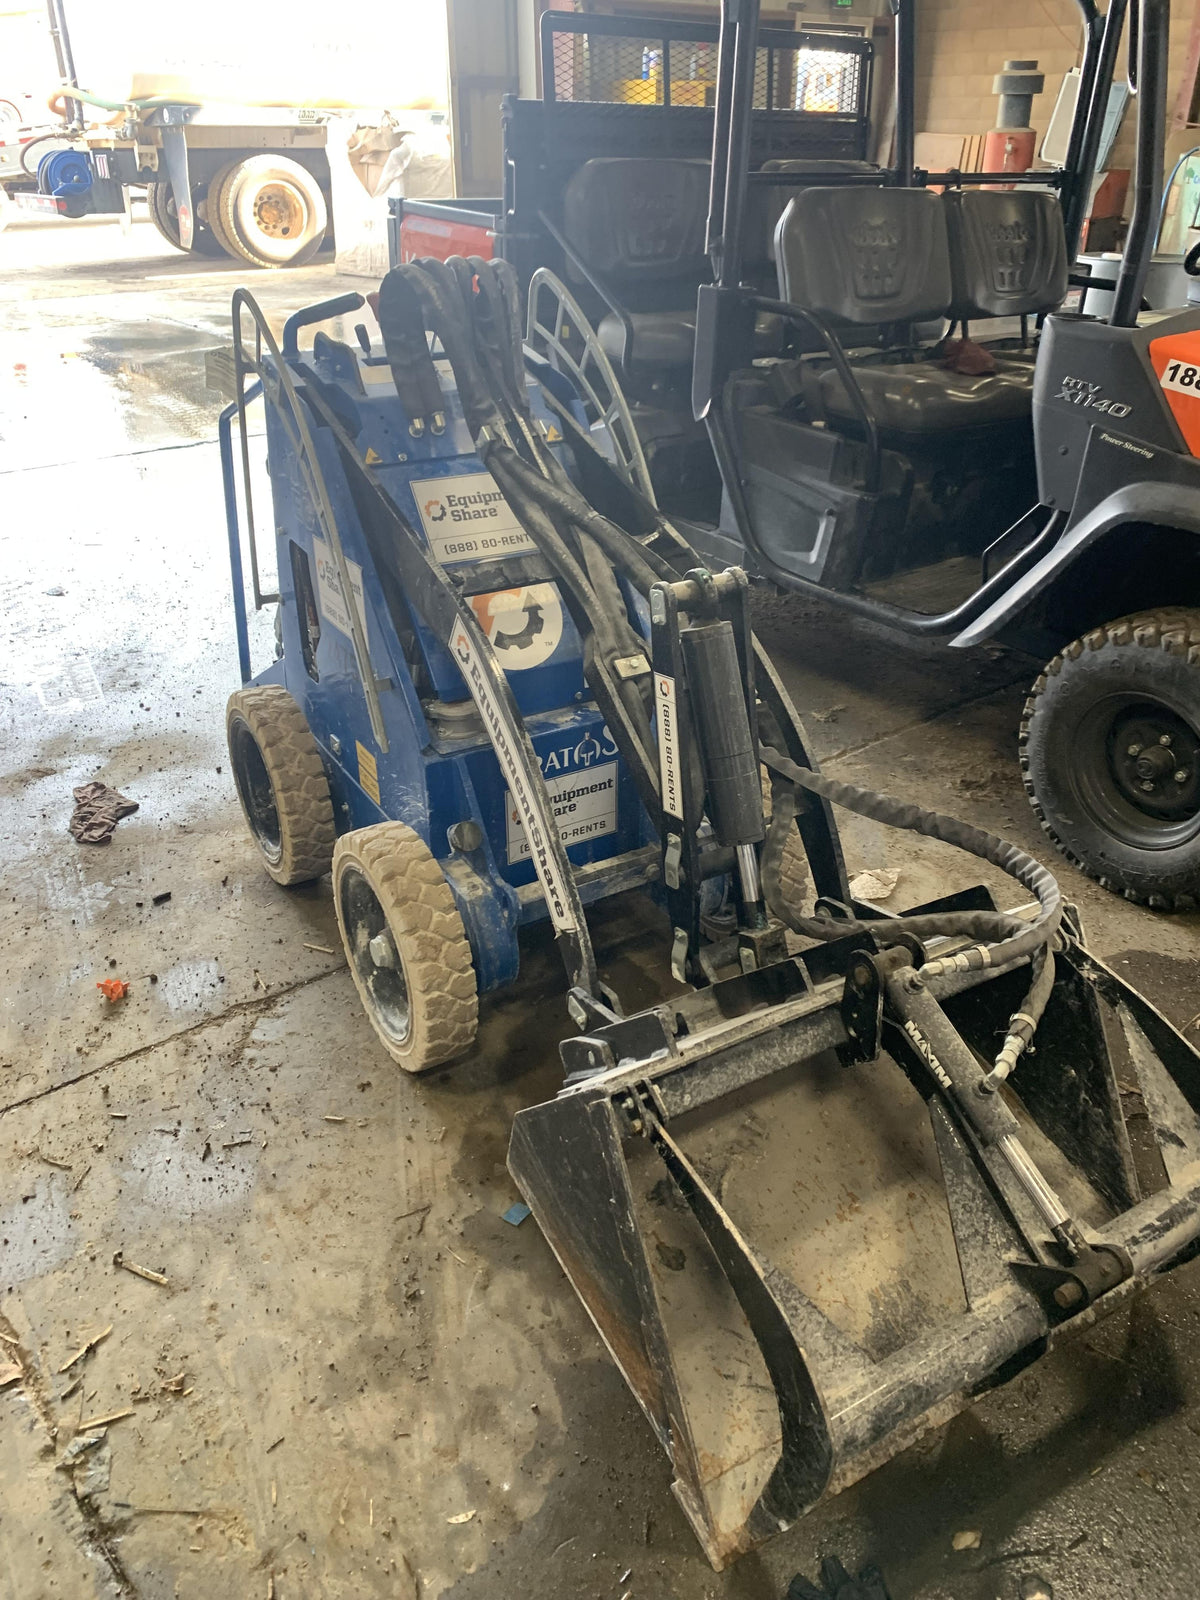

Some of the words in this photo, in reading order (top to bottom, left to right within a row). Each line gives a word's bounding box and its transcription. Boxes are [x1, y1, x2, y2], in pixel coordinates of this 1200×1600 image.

[1062, 375, 1102, 394] RTV
[1053, 386, 1133, 418] X1140
[1099, 432, 1124, 448] Power
[1123, 441, 1155, 459] Steering
[446, 491, 505, 509] Equipm
[450, 507, 499, 522] Share
[444, 540, 478, 555] (888)
[481, 533, 530, 549] 80-RENT
[662, 703, 672, 742] (888)
[469, 661, 565, 918] EquipmentShare
[550, 778, 614, 804] uipment
[665, 746, 677, 812] 80-RENTS
[553, 802, 577, 817] are
[561, 820, 607, 841] 0-RENTS
[904, 1020, 953, 1089] MAXIM
